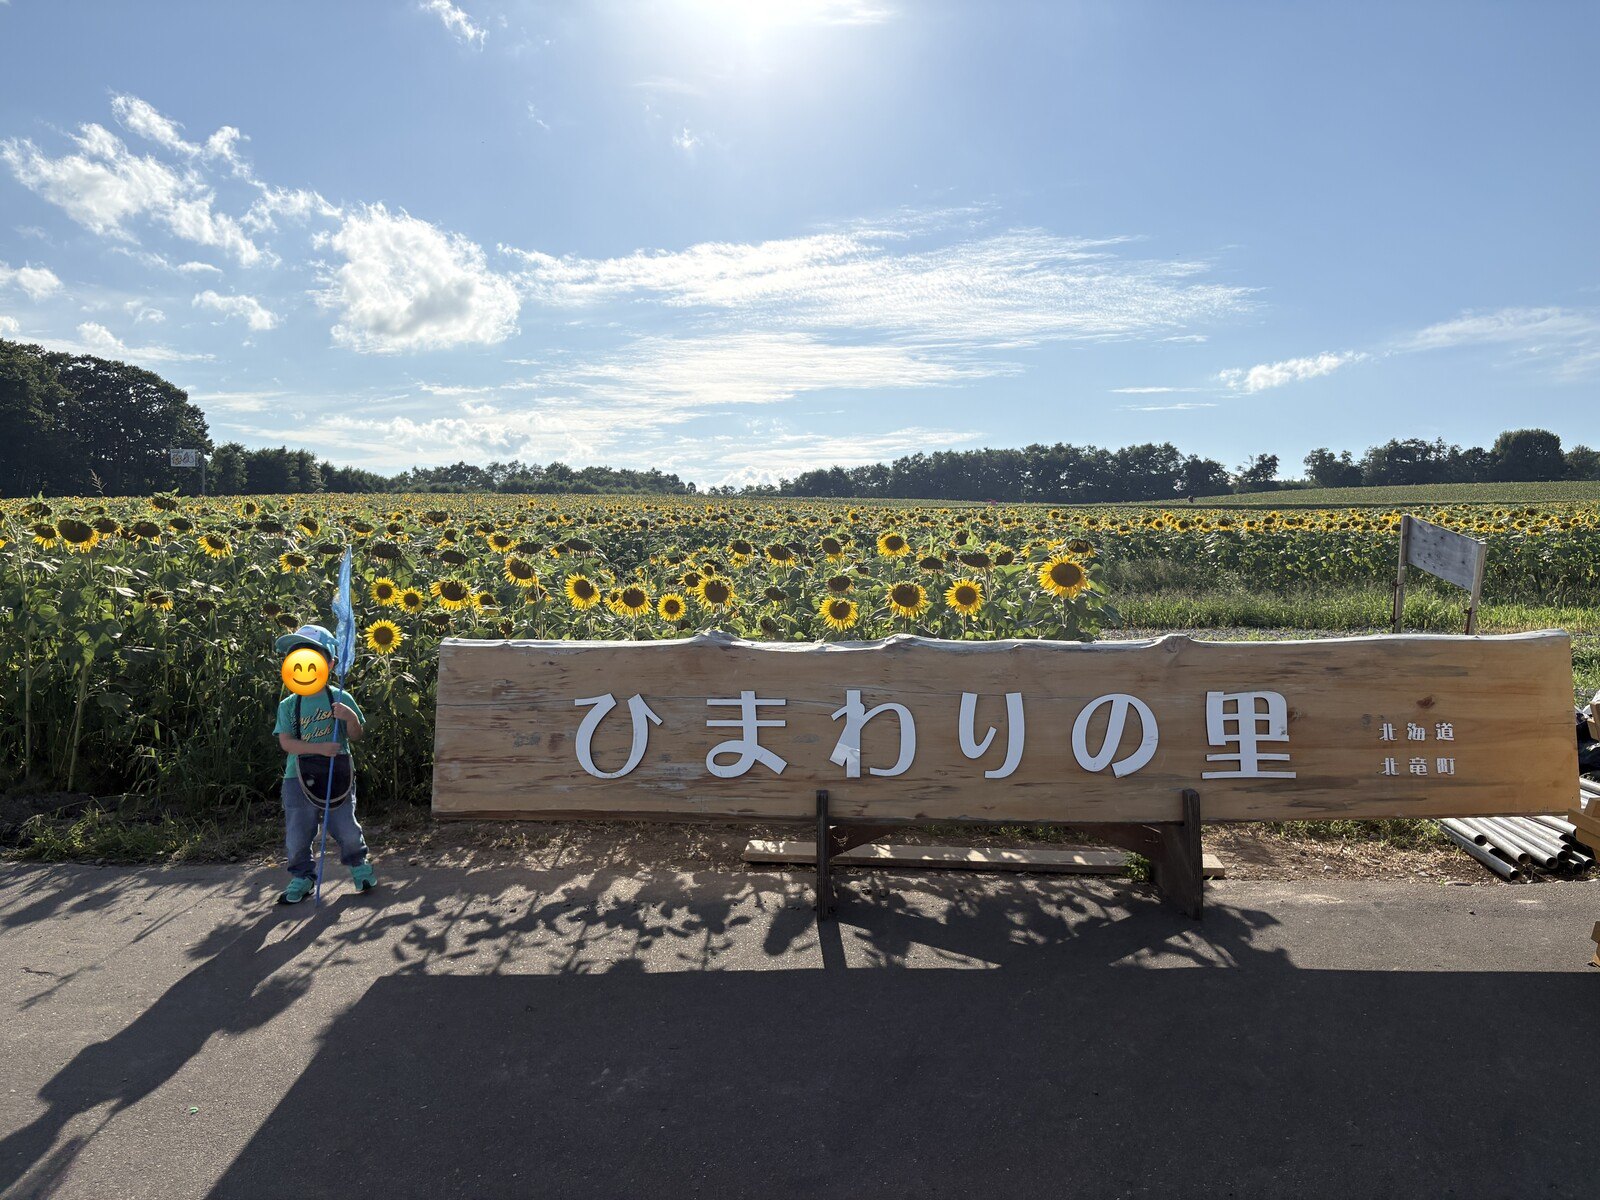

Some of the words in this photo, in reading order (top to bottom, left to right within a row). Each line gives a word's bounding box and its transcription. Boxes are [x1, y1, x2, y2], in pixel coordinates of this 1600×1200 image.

[574, 690, 1297, 780] ひまわりの里
[1379, 722, 1455, 741] 北海道
[1380, 757, 1456, 776] 北竜町
